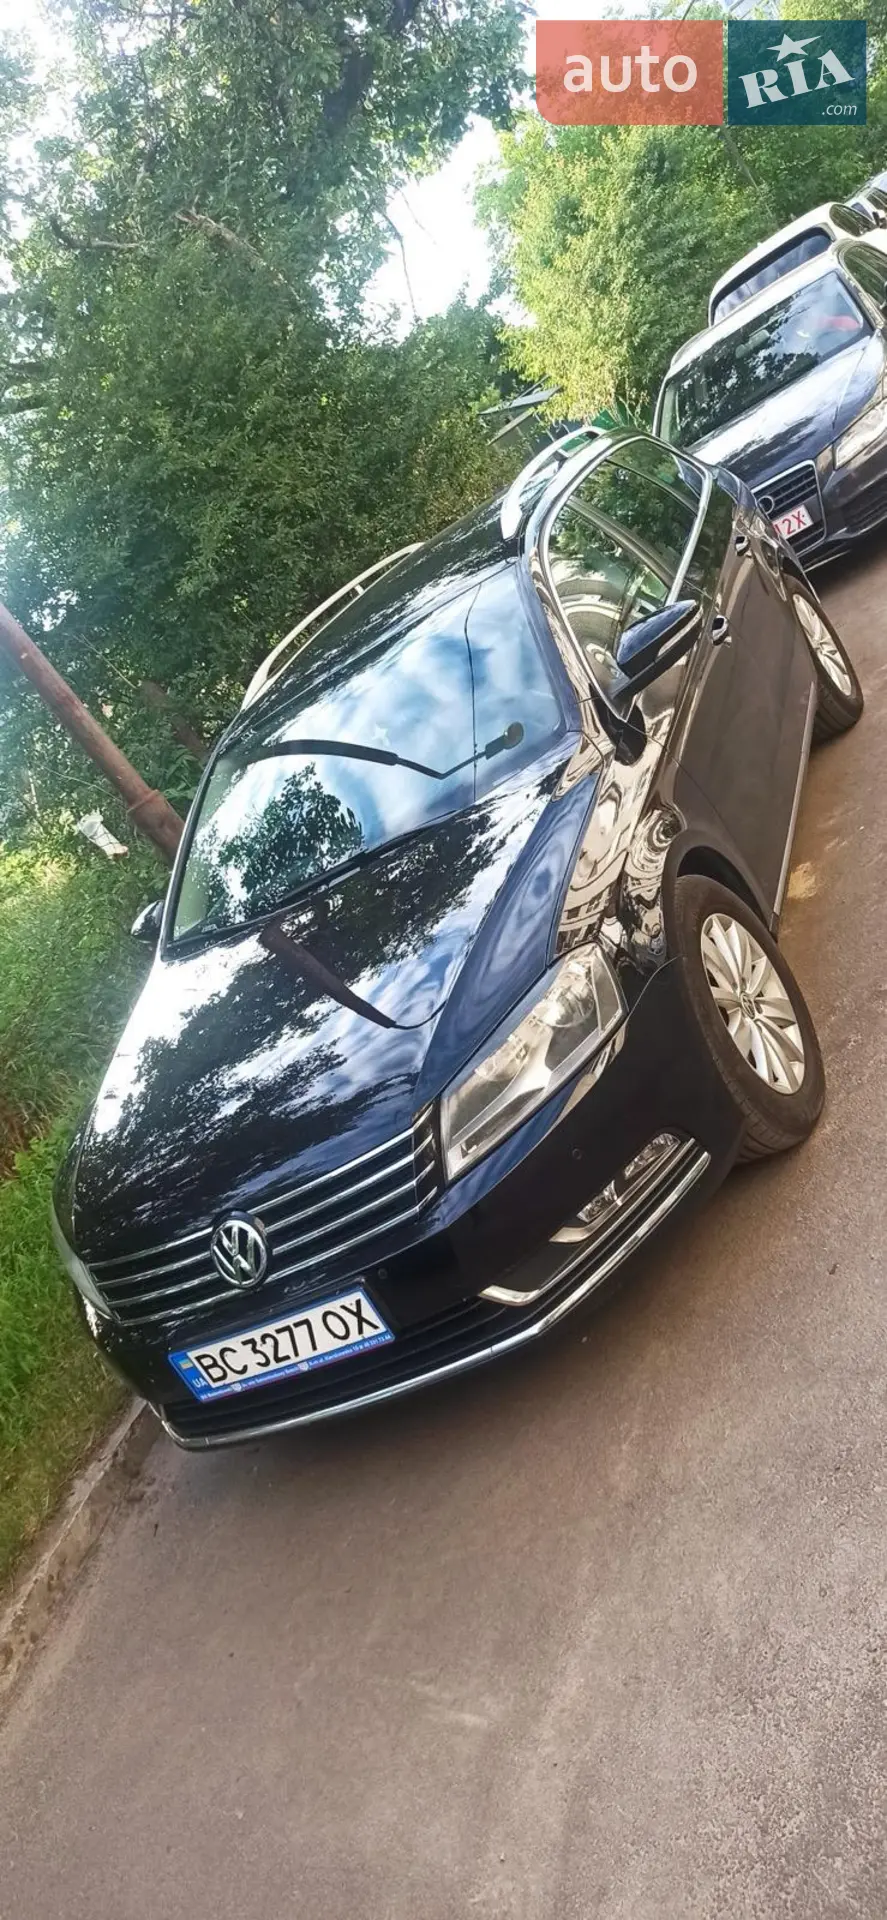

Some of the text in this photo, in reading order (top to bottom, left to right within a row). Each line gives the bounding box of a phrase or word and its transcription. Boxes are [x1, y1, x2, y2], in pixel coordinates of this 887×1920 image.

[195, 1346, 249, 1384] BC
[241, 1318, 318, 1368] 3277
[322, 1298, 380, 1341] OX
[192, 1376, 208, 1388] UA
